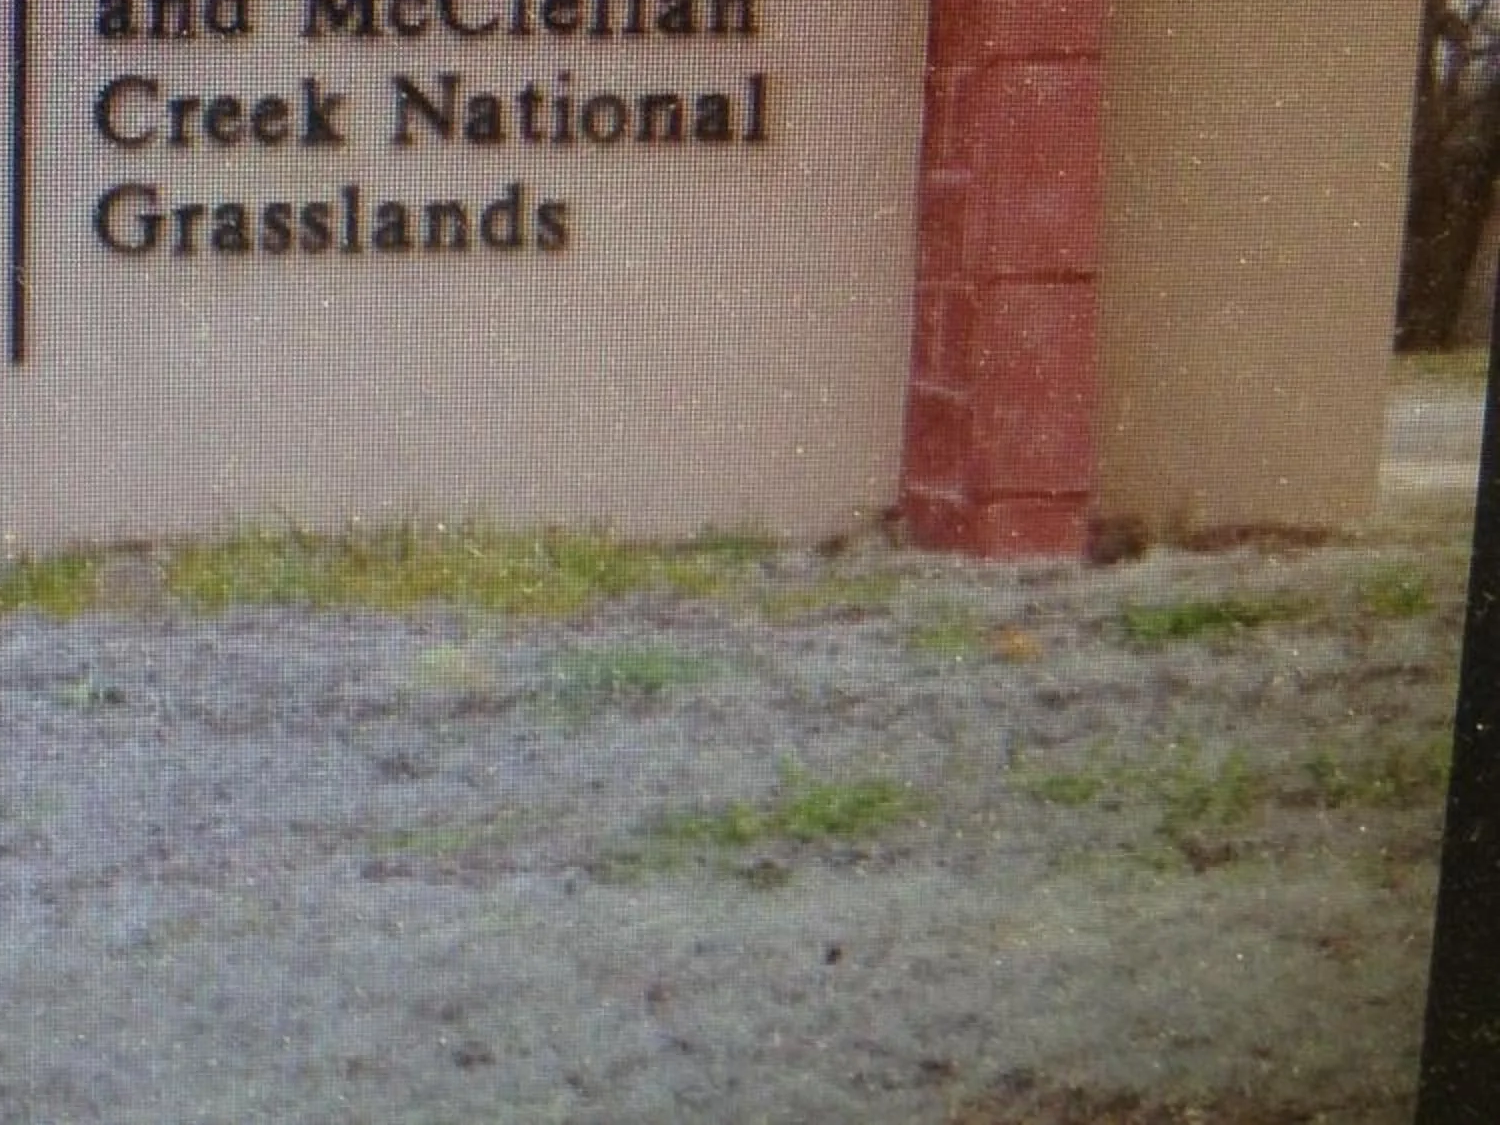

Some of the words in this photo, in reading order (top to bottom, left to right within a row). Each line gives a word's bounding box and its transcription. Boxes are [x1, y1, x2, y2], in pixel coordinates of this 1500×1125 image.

[96, 76, 347, 148] Creek
[393, 72, 767, 146] National
[94, 181, 570, 255] Grasslands
